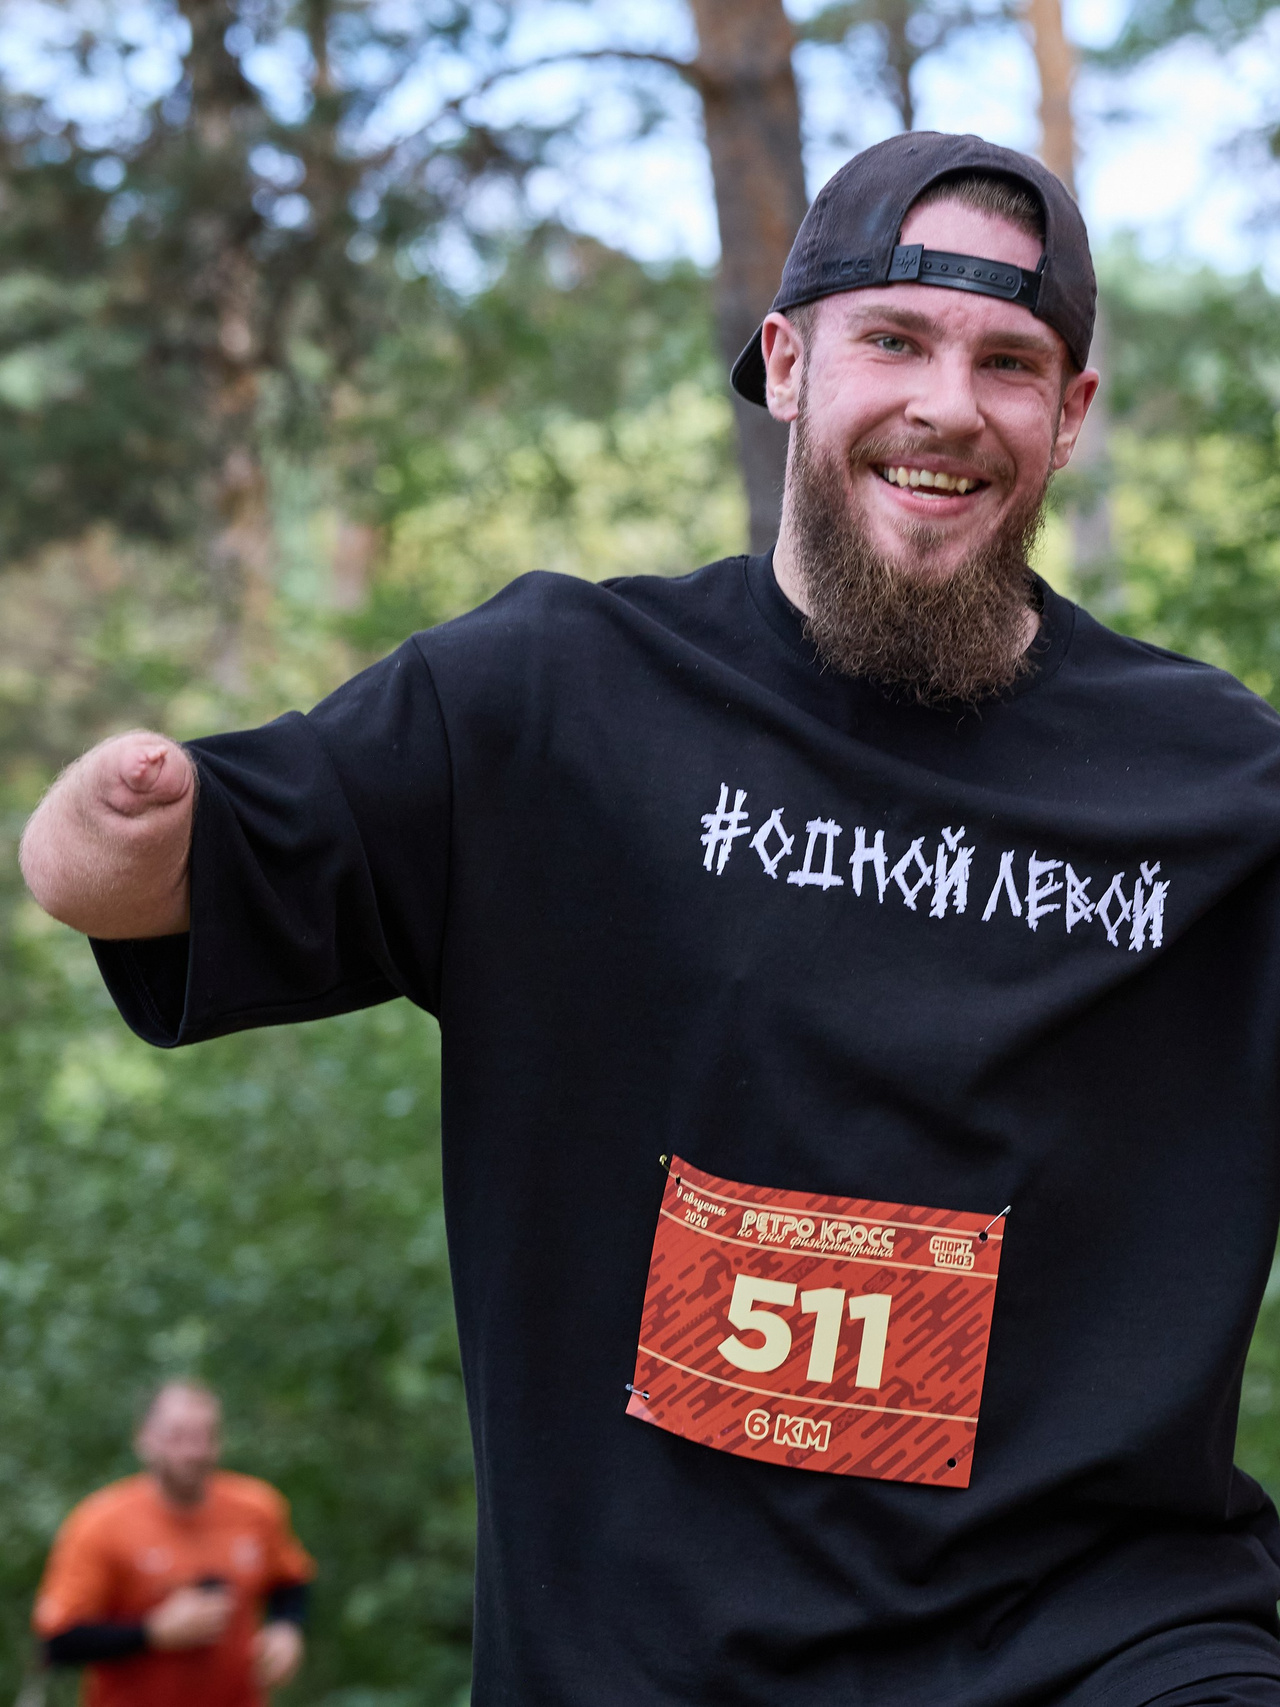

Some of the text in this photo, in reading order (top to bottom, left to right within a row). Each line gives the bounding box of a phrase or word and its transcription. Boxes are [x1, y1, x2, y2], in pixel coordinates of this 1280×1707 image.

[675, 1186, 728, 1217] 9 августа
[684, 1209, 709, 1229] 2026
[741, 1209, 896, 1250] РЕТРО КРОСС
[737, 1226, 895, 1259] ко дню физкультурника
[931, 1238, 971, 1253] СПОРТ
[936, 1252, 974, 1266] СОЮЗ
[717, 1273, 892, 1389] 511
[745, 1408, 770, 1440] 6
[773, 1413, 832, 1452] КМ
